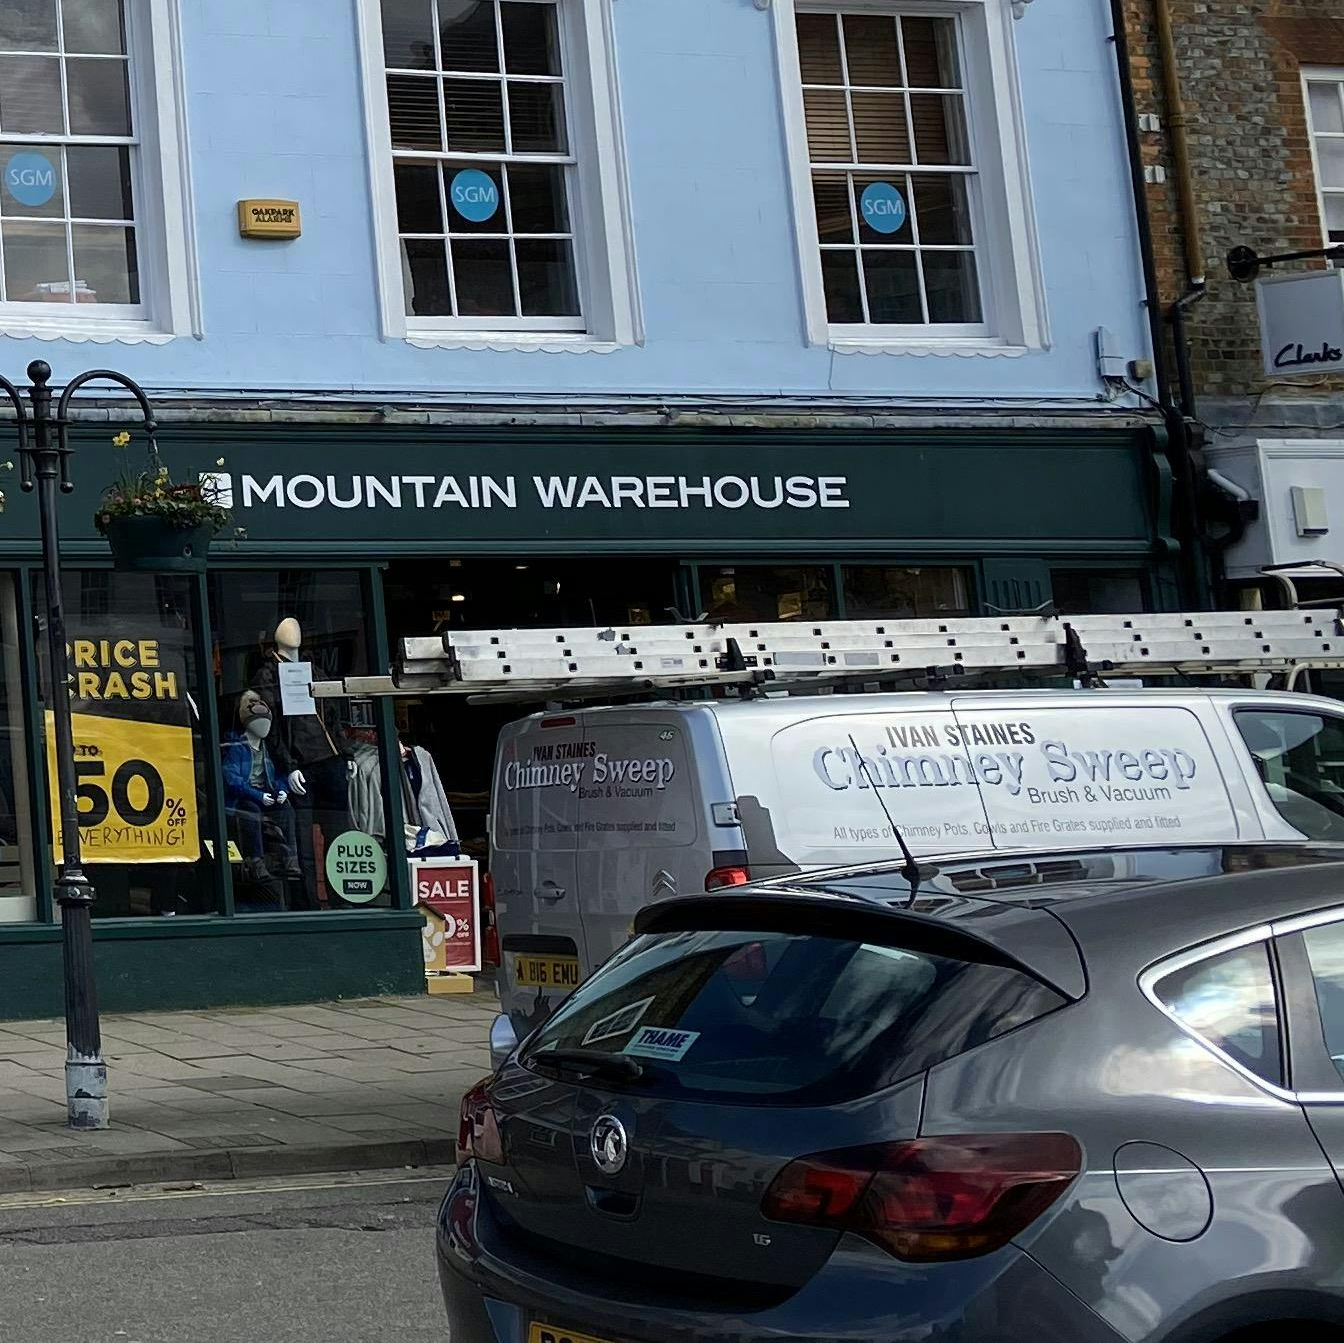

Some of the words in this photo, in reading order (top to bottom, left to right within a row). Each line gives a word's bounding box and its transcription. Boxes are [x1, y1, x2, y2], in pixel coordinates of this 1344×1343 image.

[10, 169, 52, 186] SGM
[455, 186, 495, 203] SGM
[864, 199, 902, 215] SGM
[1274, 342, 1343, 368] Clarks
[242, 474, 516, 509] MOUNTAIN
[533, 475, 850, 509] WAREHOUSE
[65, 640, 161, 668] RICE
[885, 725, 941, 748] IVAN
[944, 723, 1036, 747] STAINES
[533, 745, 554, 761] IVAN
[555, 742, 596, 759] STAINES
[505, 760, 585, 792] Chimney
[593, 753, 674, 790] Sweep
[813, 745, 1025, 795] Chimney
[1040, 740, 1196, 789] Sweep
[578, 787, 603, 799] Brush
[606, 787, 612, 798] &
[615, 786, 653, 798] Vacuum
[1027, 786, 1080, 804] Brush
[1084, 785, 1097, 802] &
[1099, 785, 1171, 801] Vacuum
[167, 818, 187, 827] OFF
[834, 826, 846, 839] All
[849, 827, 879, 842] types
[882, 825, 893, 837] of
[895, 823, 941, 839] Chimney
[1011, 822, 1028, 833] and
[1031, 819, 1050, 833] Fire
[1053, 818, 1087, 832] Grates
[1089, 816, 1131, 833] supplied
[1134, 816, 1153, 829] and
[1155, 815, 1181, 828] fitted
[337, 845, 373, 857] PLUS
[336, 861, 377, 874] SIZES
[419, 880, 469, 899] SALE
[553, 962, 578, 985] EMU
[638, 1029, 690, 1048] THAME
